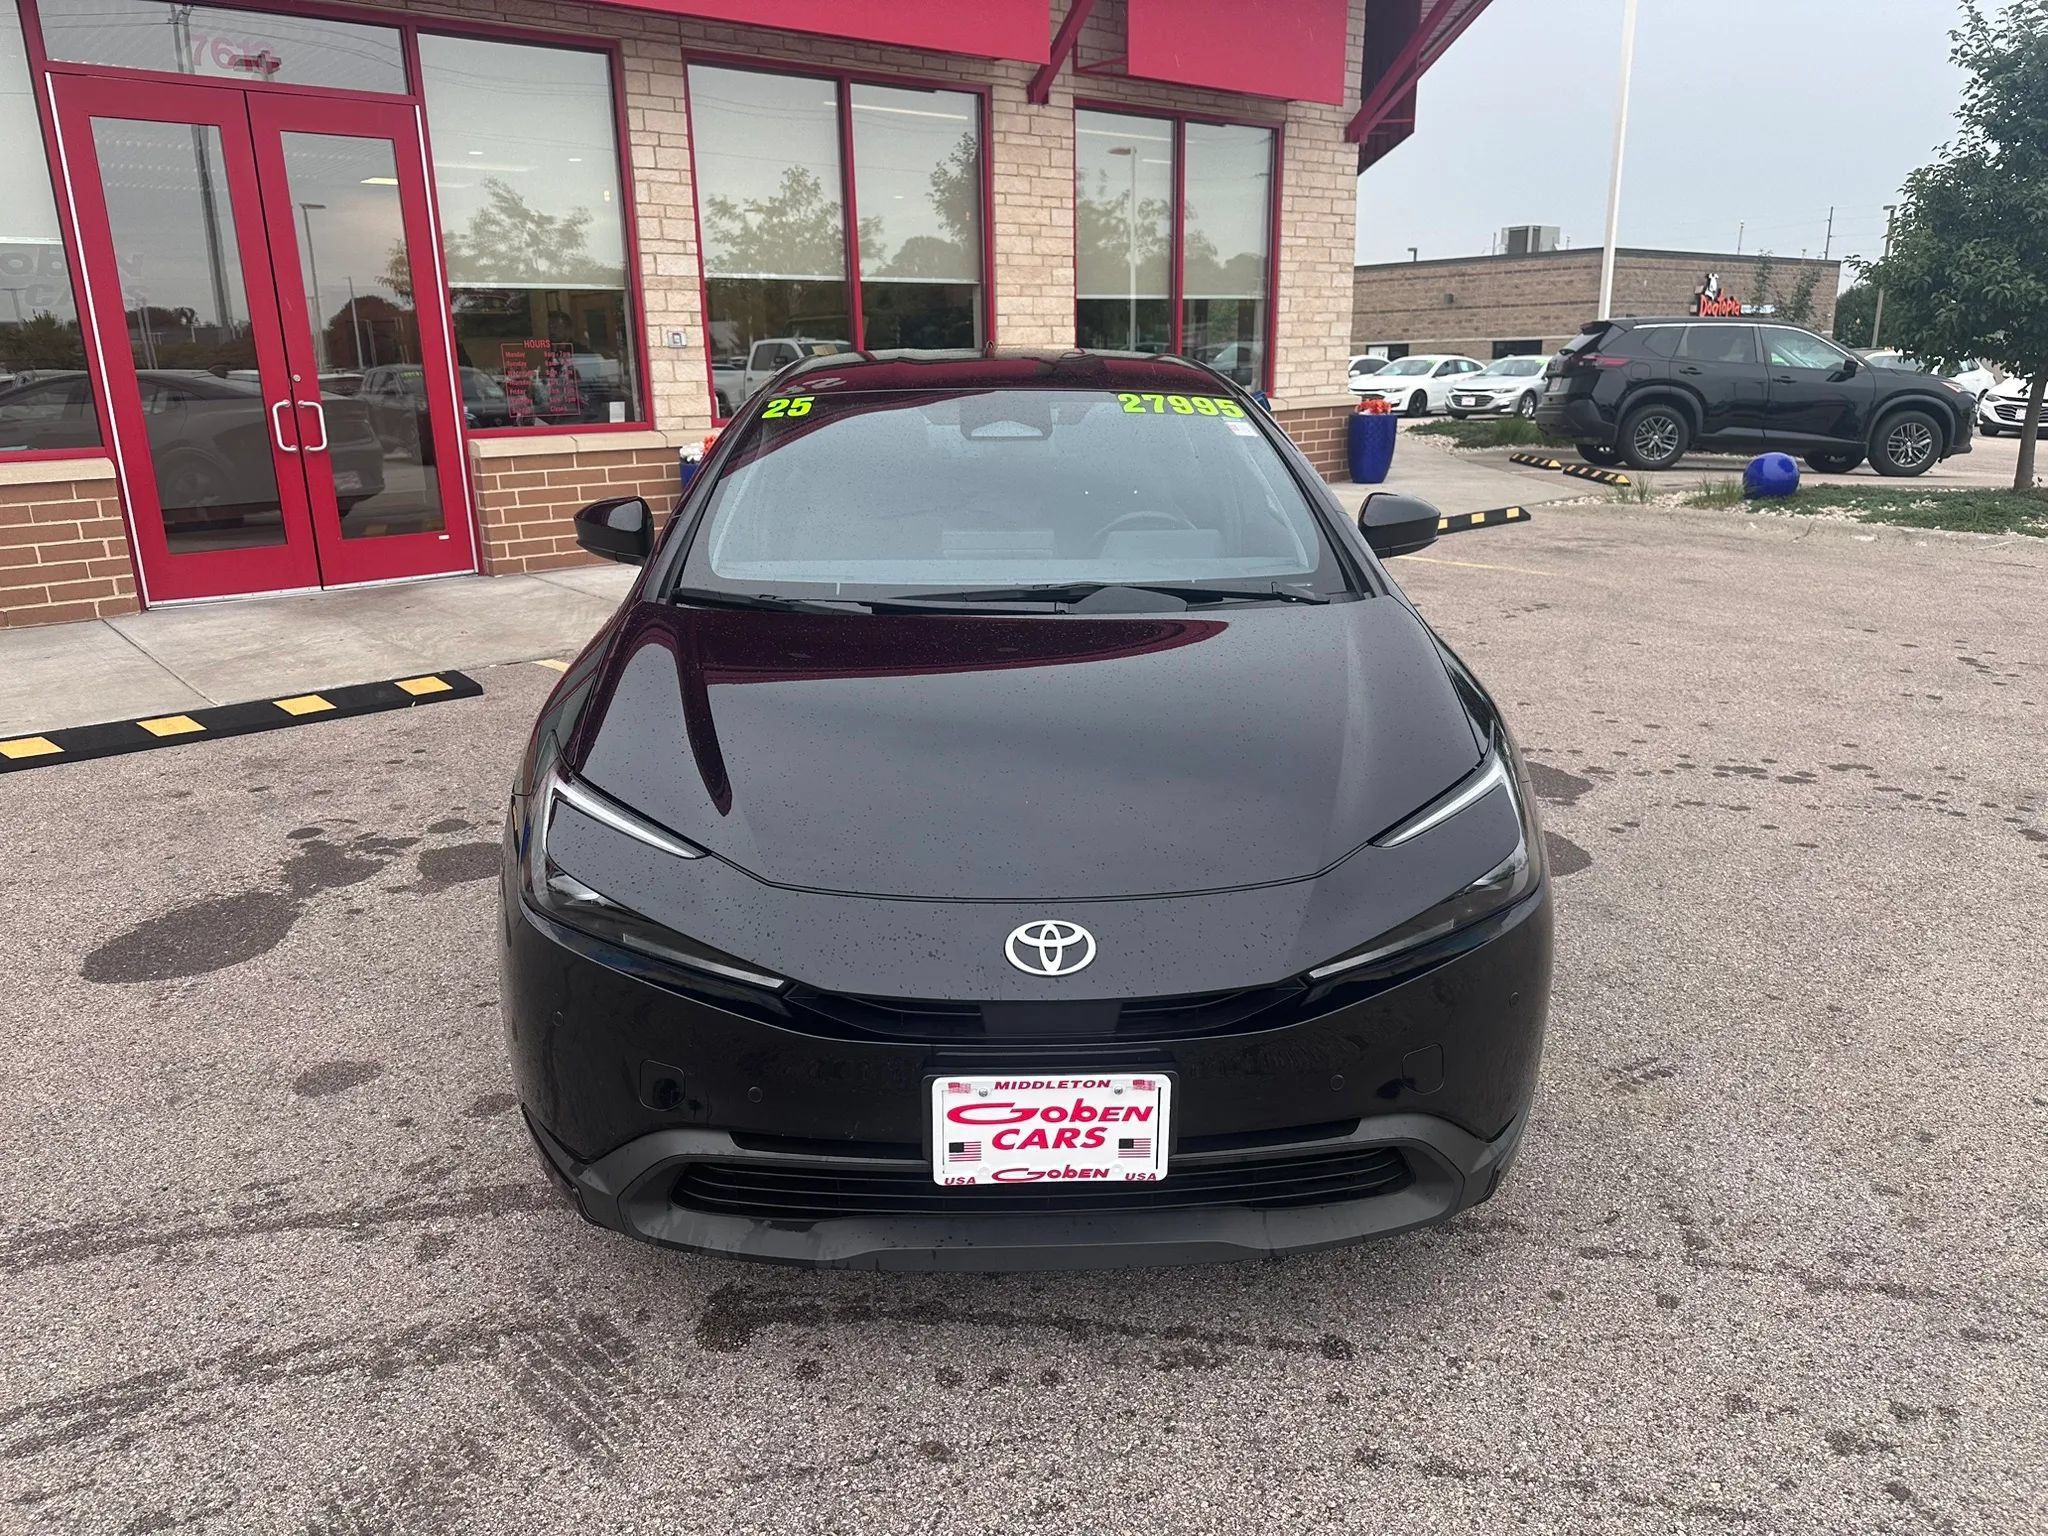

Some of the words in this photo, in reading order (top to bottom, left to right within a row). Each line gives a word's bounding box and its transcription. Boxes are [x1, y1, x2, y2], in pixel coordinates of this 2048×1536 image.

[524, 339, 551, 349] HOURS
[761, 396, 816, 419] 25
[1117, 393, 1245, 419] 27995
[994, 1079, 1112, 1090] MIDDLETON
[991, 1126, 1108, 1151] CARS
[944, 1176, 977, 1186] USA
[1124, 1172, 1157, 1182] USA
